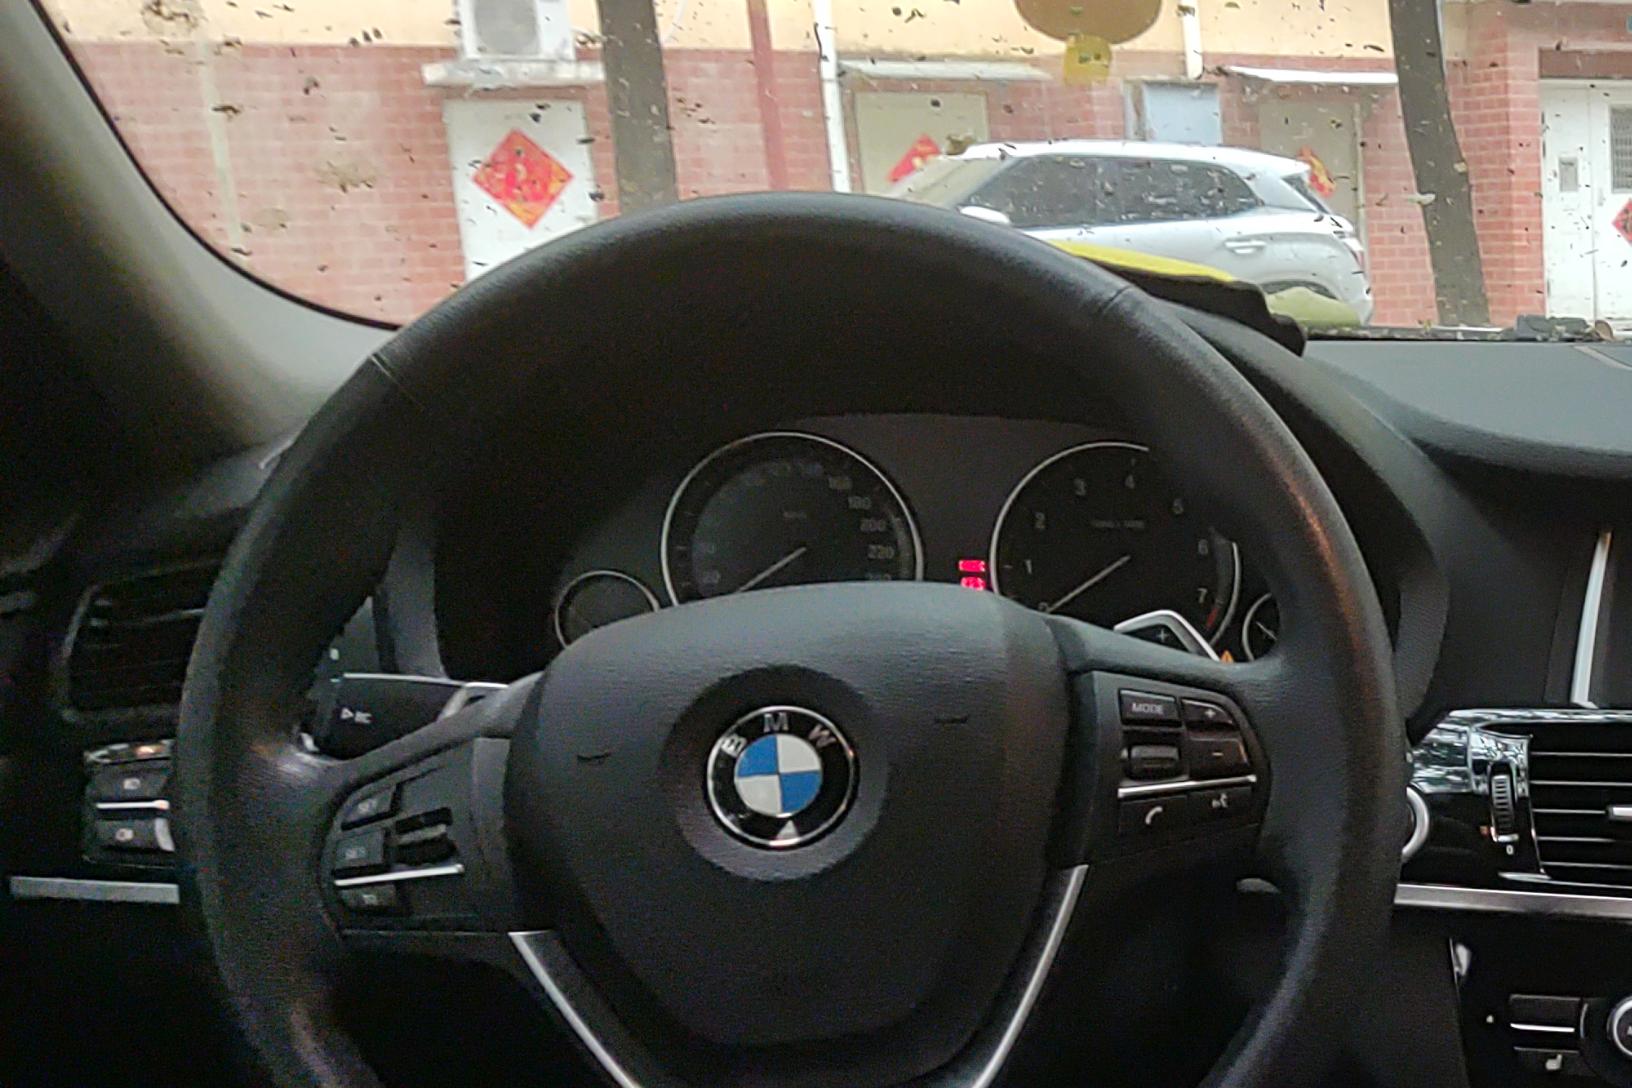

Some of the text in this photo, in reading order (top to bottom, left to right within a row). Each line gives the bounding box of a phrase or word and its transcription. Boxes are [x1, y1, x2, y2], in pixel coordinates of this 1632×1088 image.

[1197, 587, 1208, 605] 7
[1131, 702, 1164, 715] MODE
[720, 712, 837, 758] BMW
